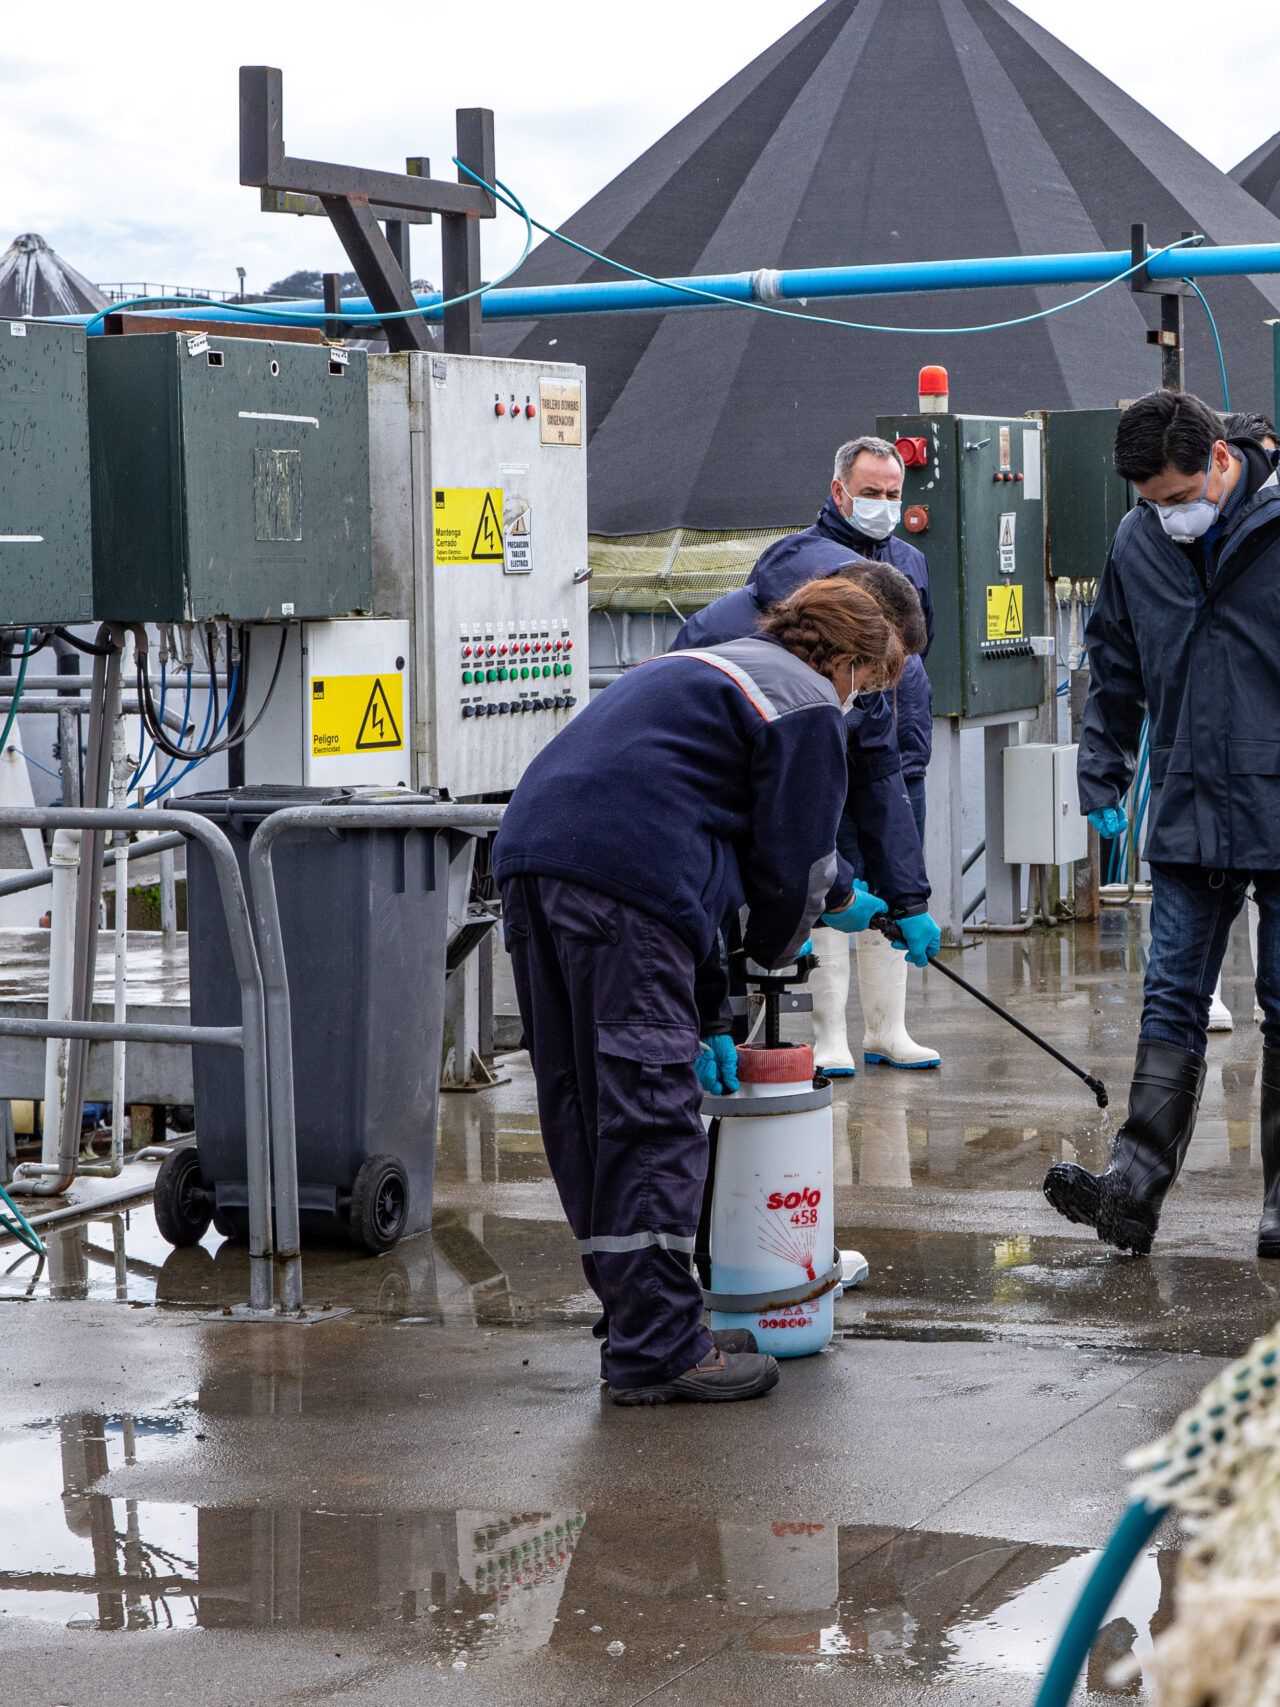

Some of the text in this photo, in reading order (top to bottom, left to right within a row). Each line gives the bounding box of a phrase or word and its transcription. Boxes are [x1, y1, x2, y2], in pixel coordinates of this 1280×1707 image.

[541, 398, 579, 411] TABLERO BOMBAS
[435, 528, 461, 539] Mantenga
[436, 539, 457, 548] Cerrado
[511, 550, 527, 558] TABLERO
[313, 734, 339, 746] Peligro
[313, 746, 341, 754] Electricidad
[766, 1187, 821, 1210] solo
[790, 1209, 818, 1225] 458
